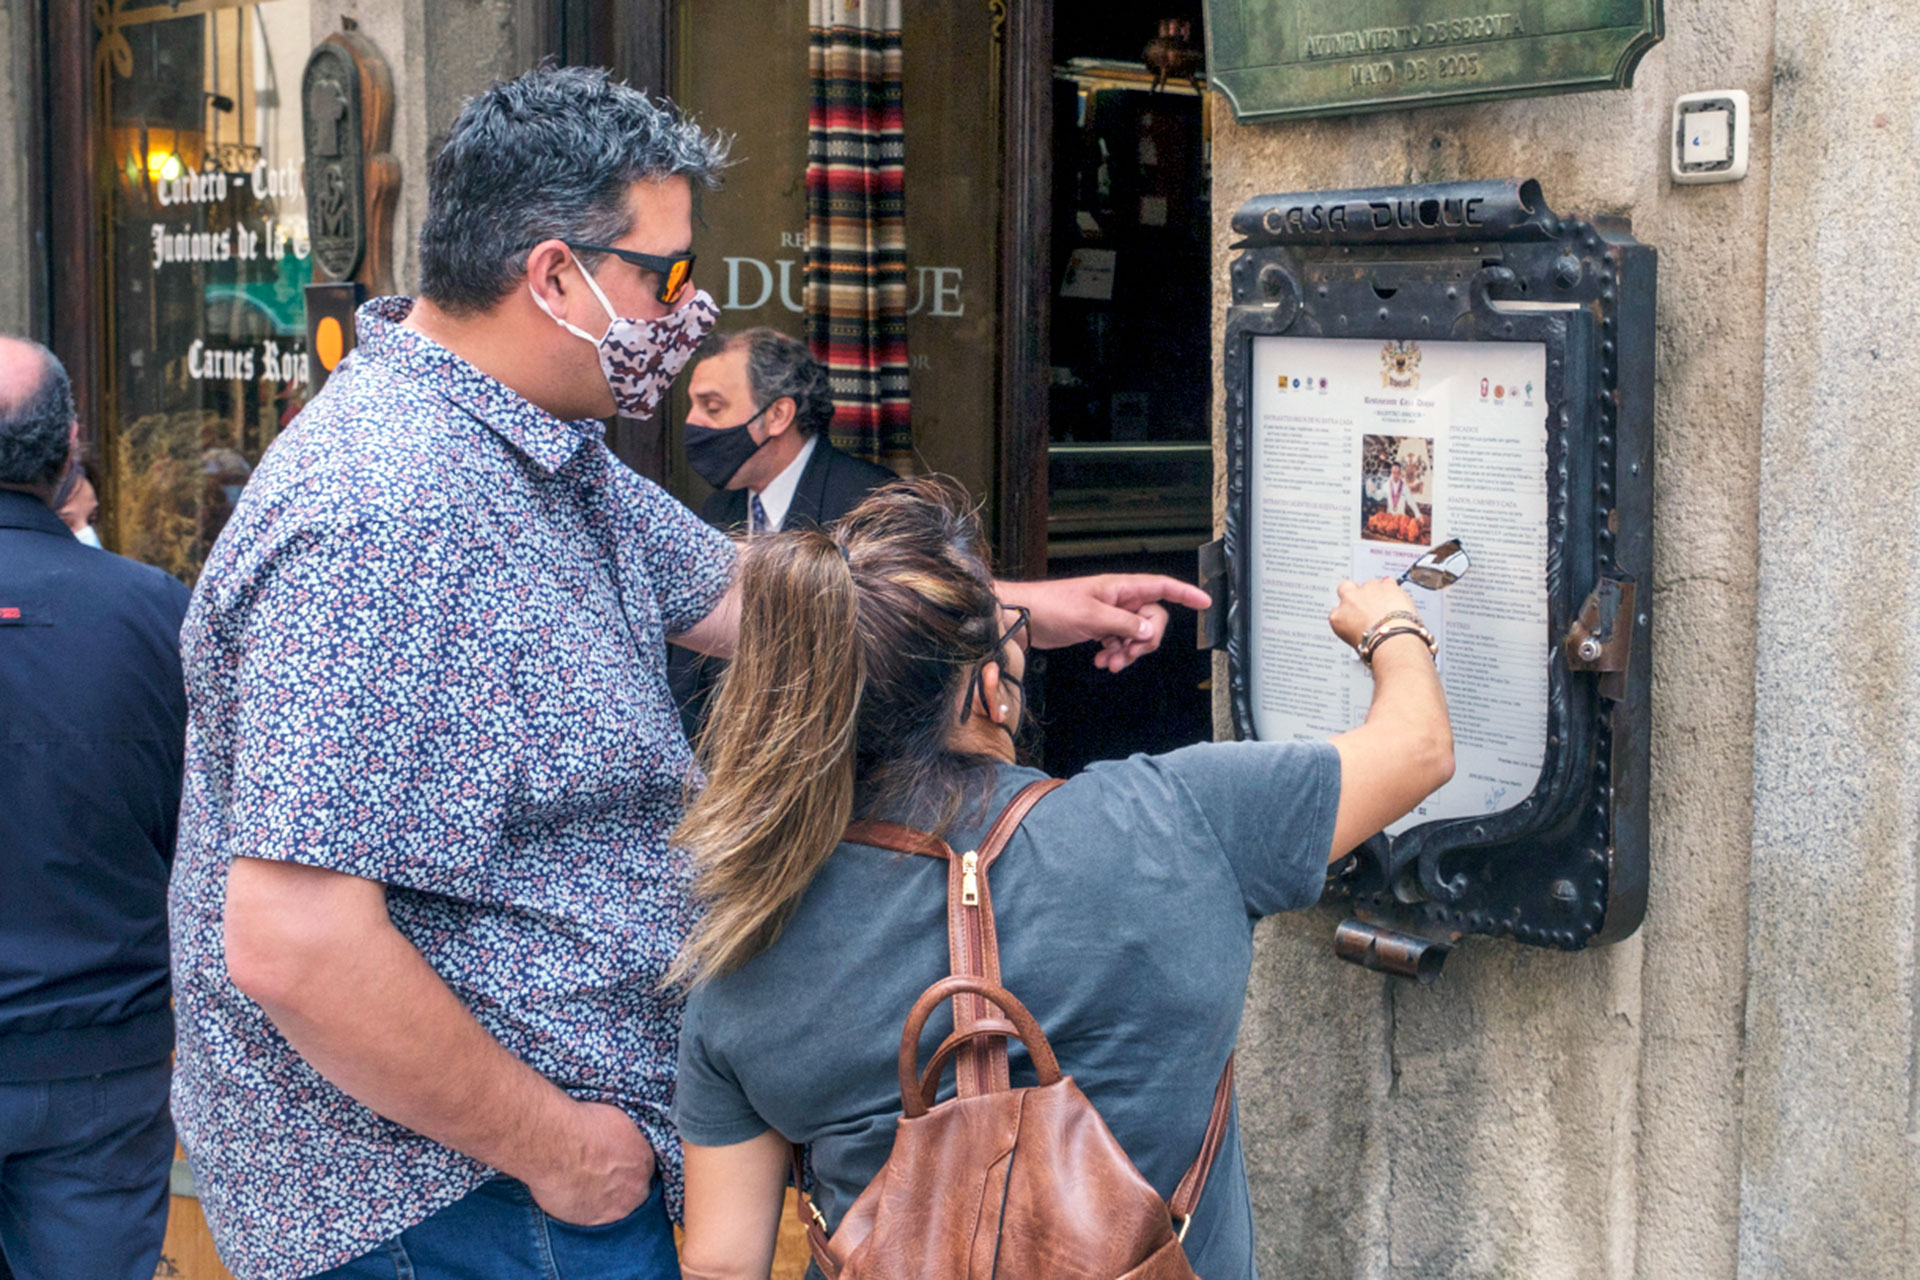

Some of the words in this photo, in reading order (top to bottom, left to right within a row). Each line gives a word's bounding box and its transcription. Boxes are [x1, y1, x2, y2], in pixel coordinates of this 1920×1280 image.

[1426, 21, 1448, 44] DE
[1452, 13, 1524, 42] SEGOVIA
[1351, 61, 1395, 87] MAYO
[1404, 58, 1427, 81] DE
[1263, 205, 1348, 234] CASA
[1368, 198, 1484, 231] DUQUE
[237, 221, 258, 262] de
[188, 339, 255, 382] Carnes
